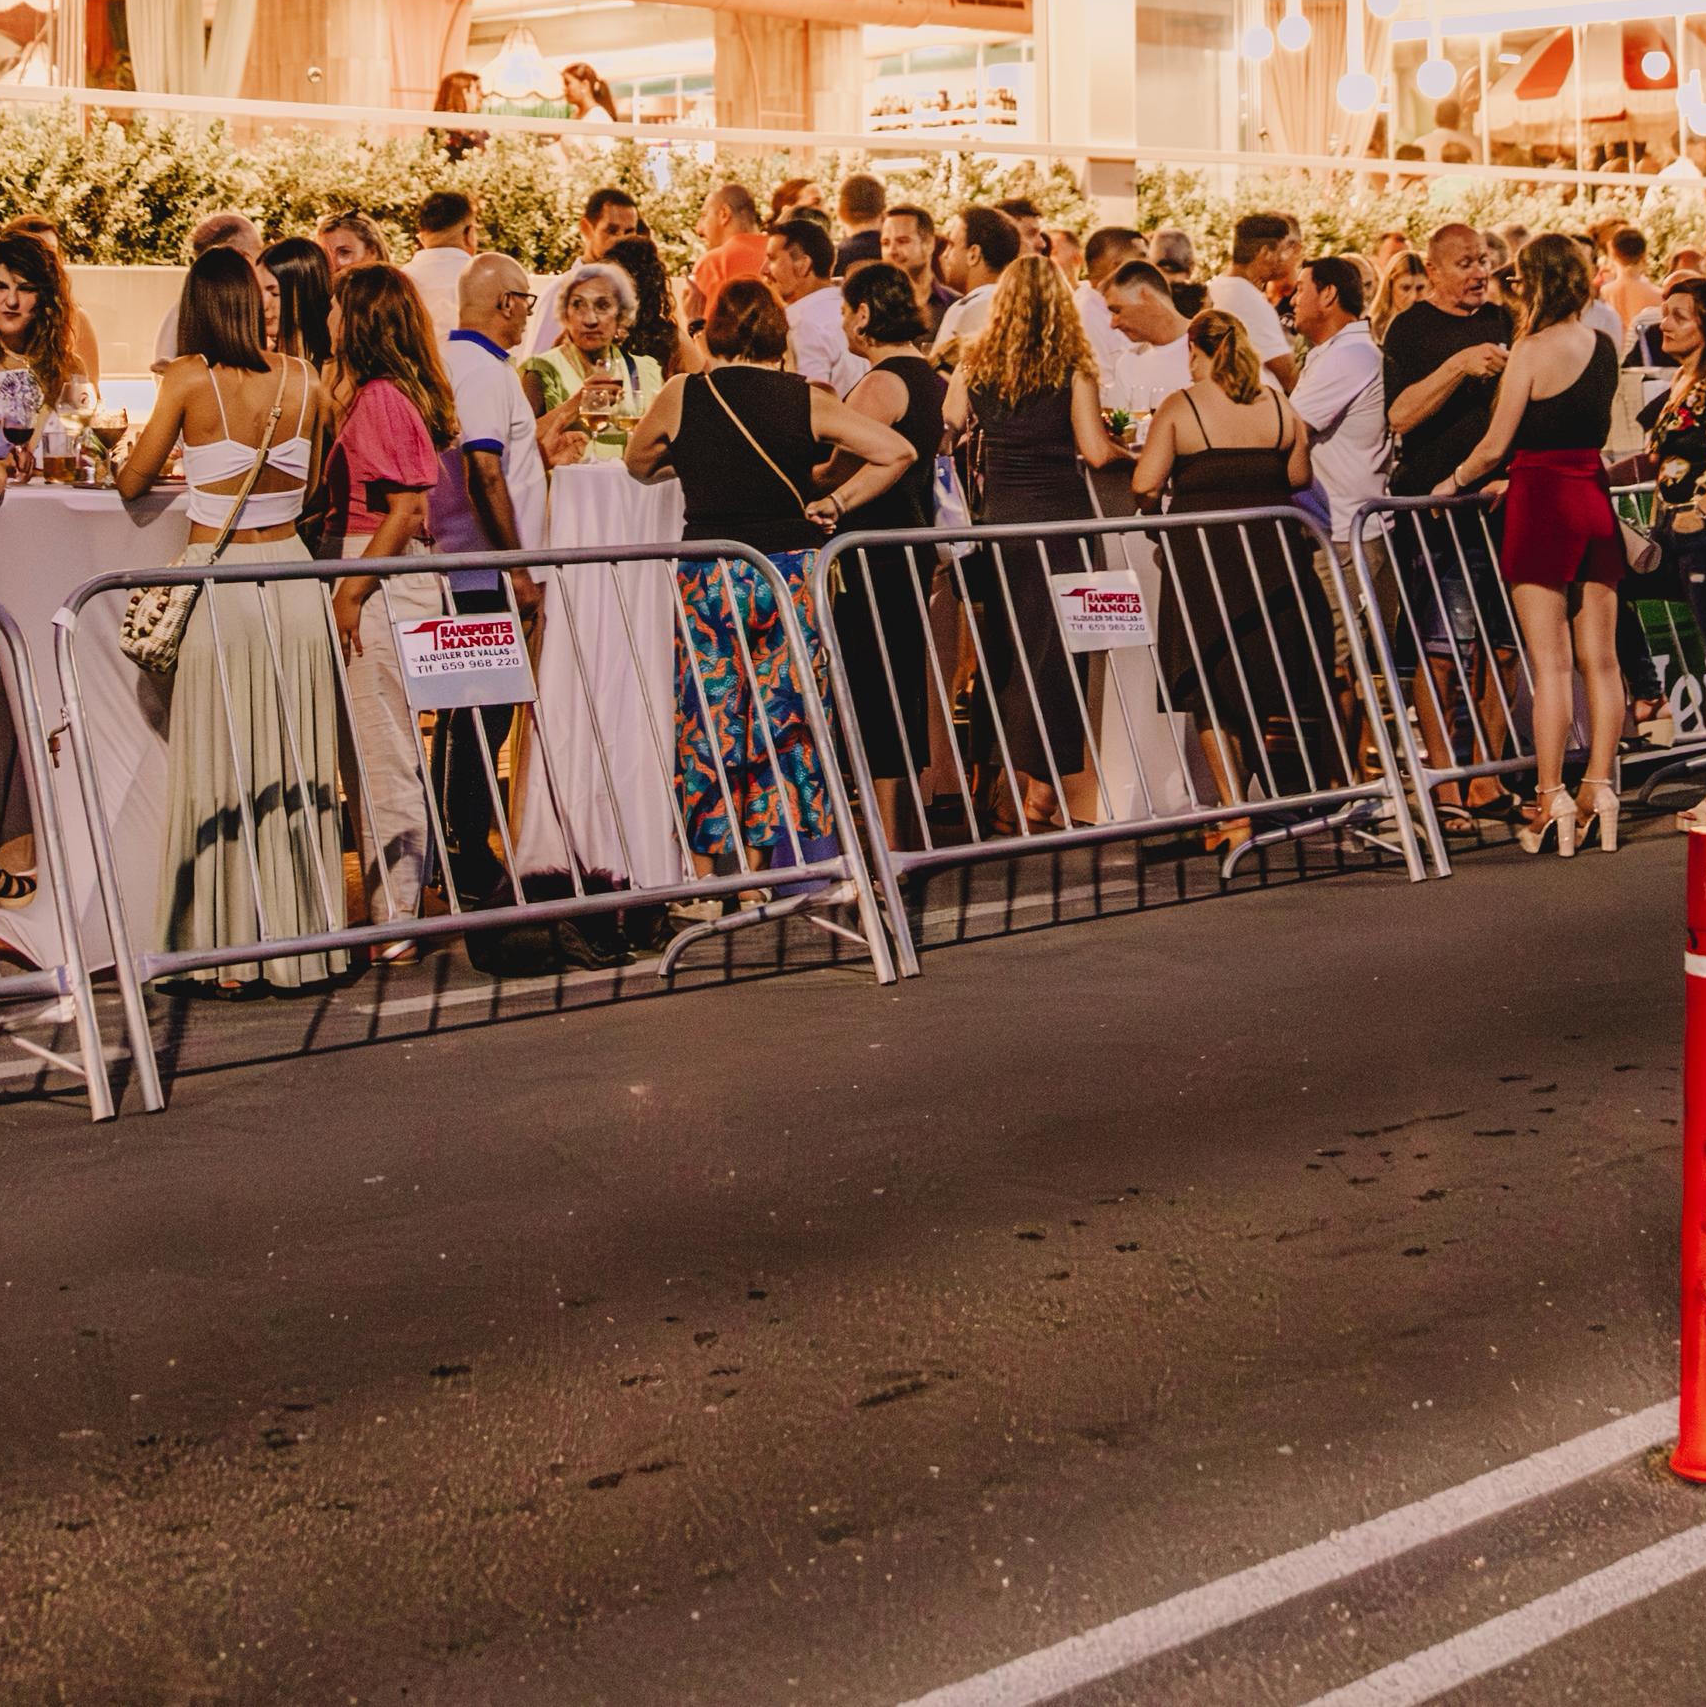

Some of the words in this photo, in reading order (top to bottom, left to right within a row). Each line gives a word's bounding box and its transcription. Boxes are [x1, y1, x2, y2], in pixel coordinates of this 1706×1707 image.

[1088, 604, 1142, 614] MANOLO
[440, 634, 515, 650] MANOLO
[419, 651, 461, 663] ALQUILER
[464, 650, 476, 658] DE
[478, 648, 510, 657] VALLAS
[441, 662, 465, 672] 659
[469, 660, 493, 669] 968
[497, 657, 520, 667] 220
